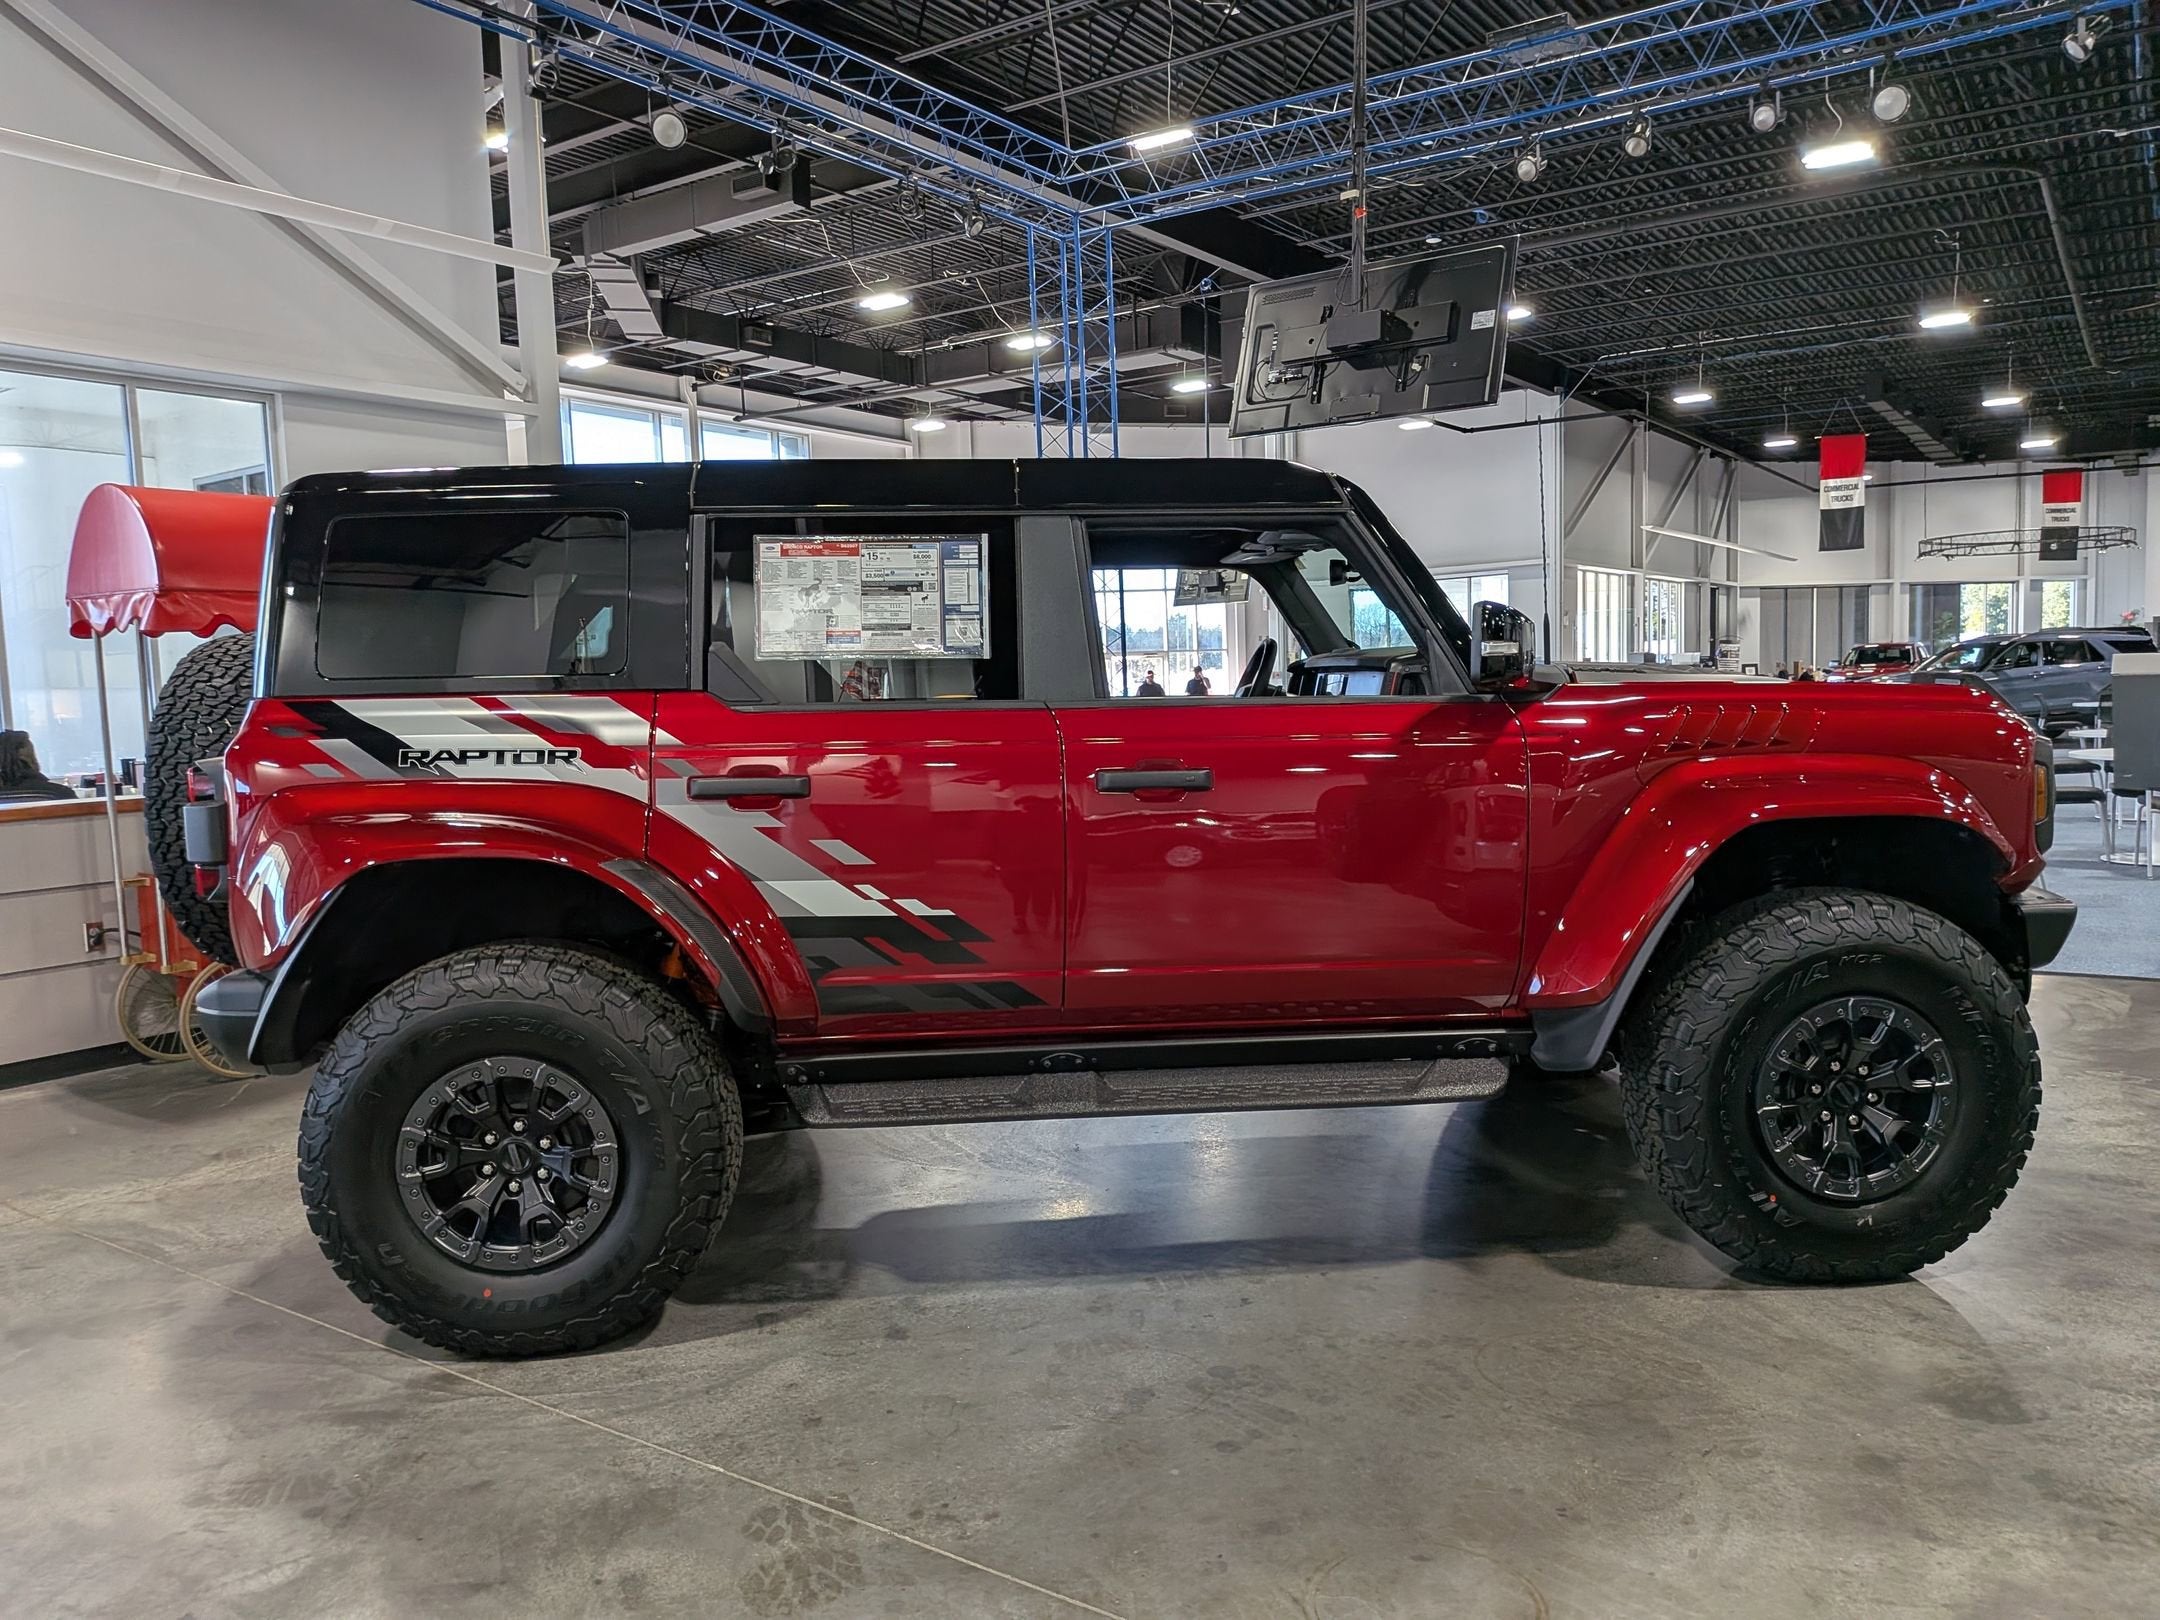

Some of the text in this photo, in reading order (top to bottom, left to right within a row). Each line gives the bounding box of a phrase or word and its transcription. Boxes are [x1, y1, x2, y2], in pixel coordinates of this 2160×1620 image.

[1823, 483, 1860, 492] COMMERCIAL
[1830, 495, 1854, 503] TRUCKS
[866, 552, 879, 561] 15
[398, 748, 586, 776] RAPTOR
